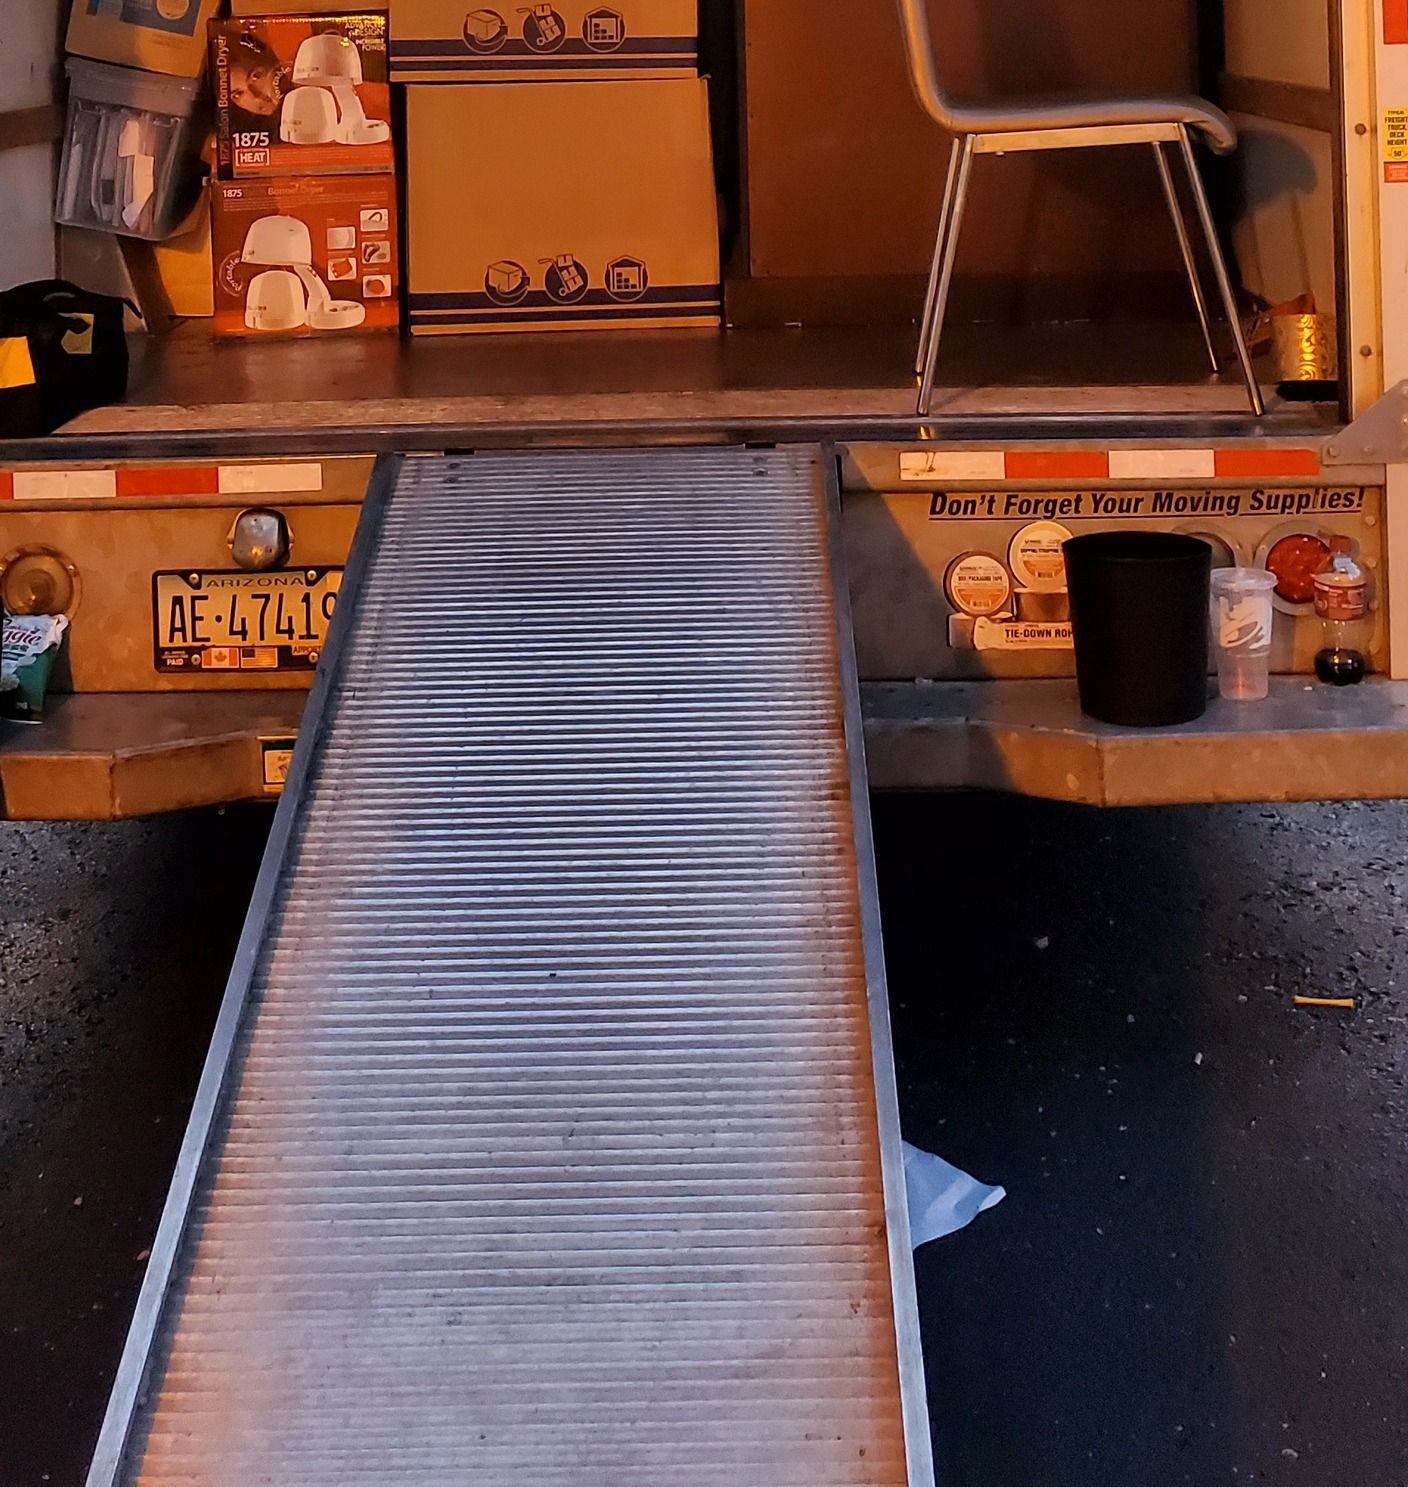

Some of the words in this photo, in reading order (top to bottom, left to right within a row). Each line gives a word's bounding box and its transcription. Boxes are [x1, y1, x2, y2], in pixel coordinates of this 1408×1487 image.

[216, 34, 230, 66] Dryer
[218, 67, 229, 108] Bonnet
[232, 132, 270, 147] 1875
[223, 188, 243, 198] 1875
[928, 492, 996, 516] Don't
[1004, 493, 1083, 520] Forget
[1091, 493, 1145, 515] Your
[1151, 490, 1241, 517] Moving
[1249, 486, 1365, 515] Supplies!
[206, 576, 304, 588] ARIZONA
[1004, 628, 1052, 638] TIE-DOWN
